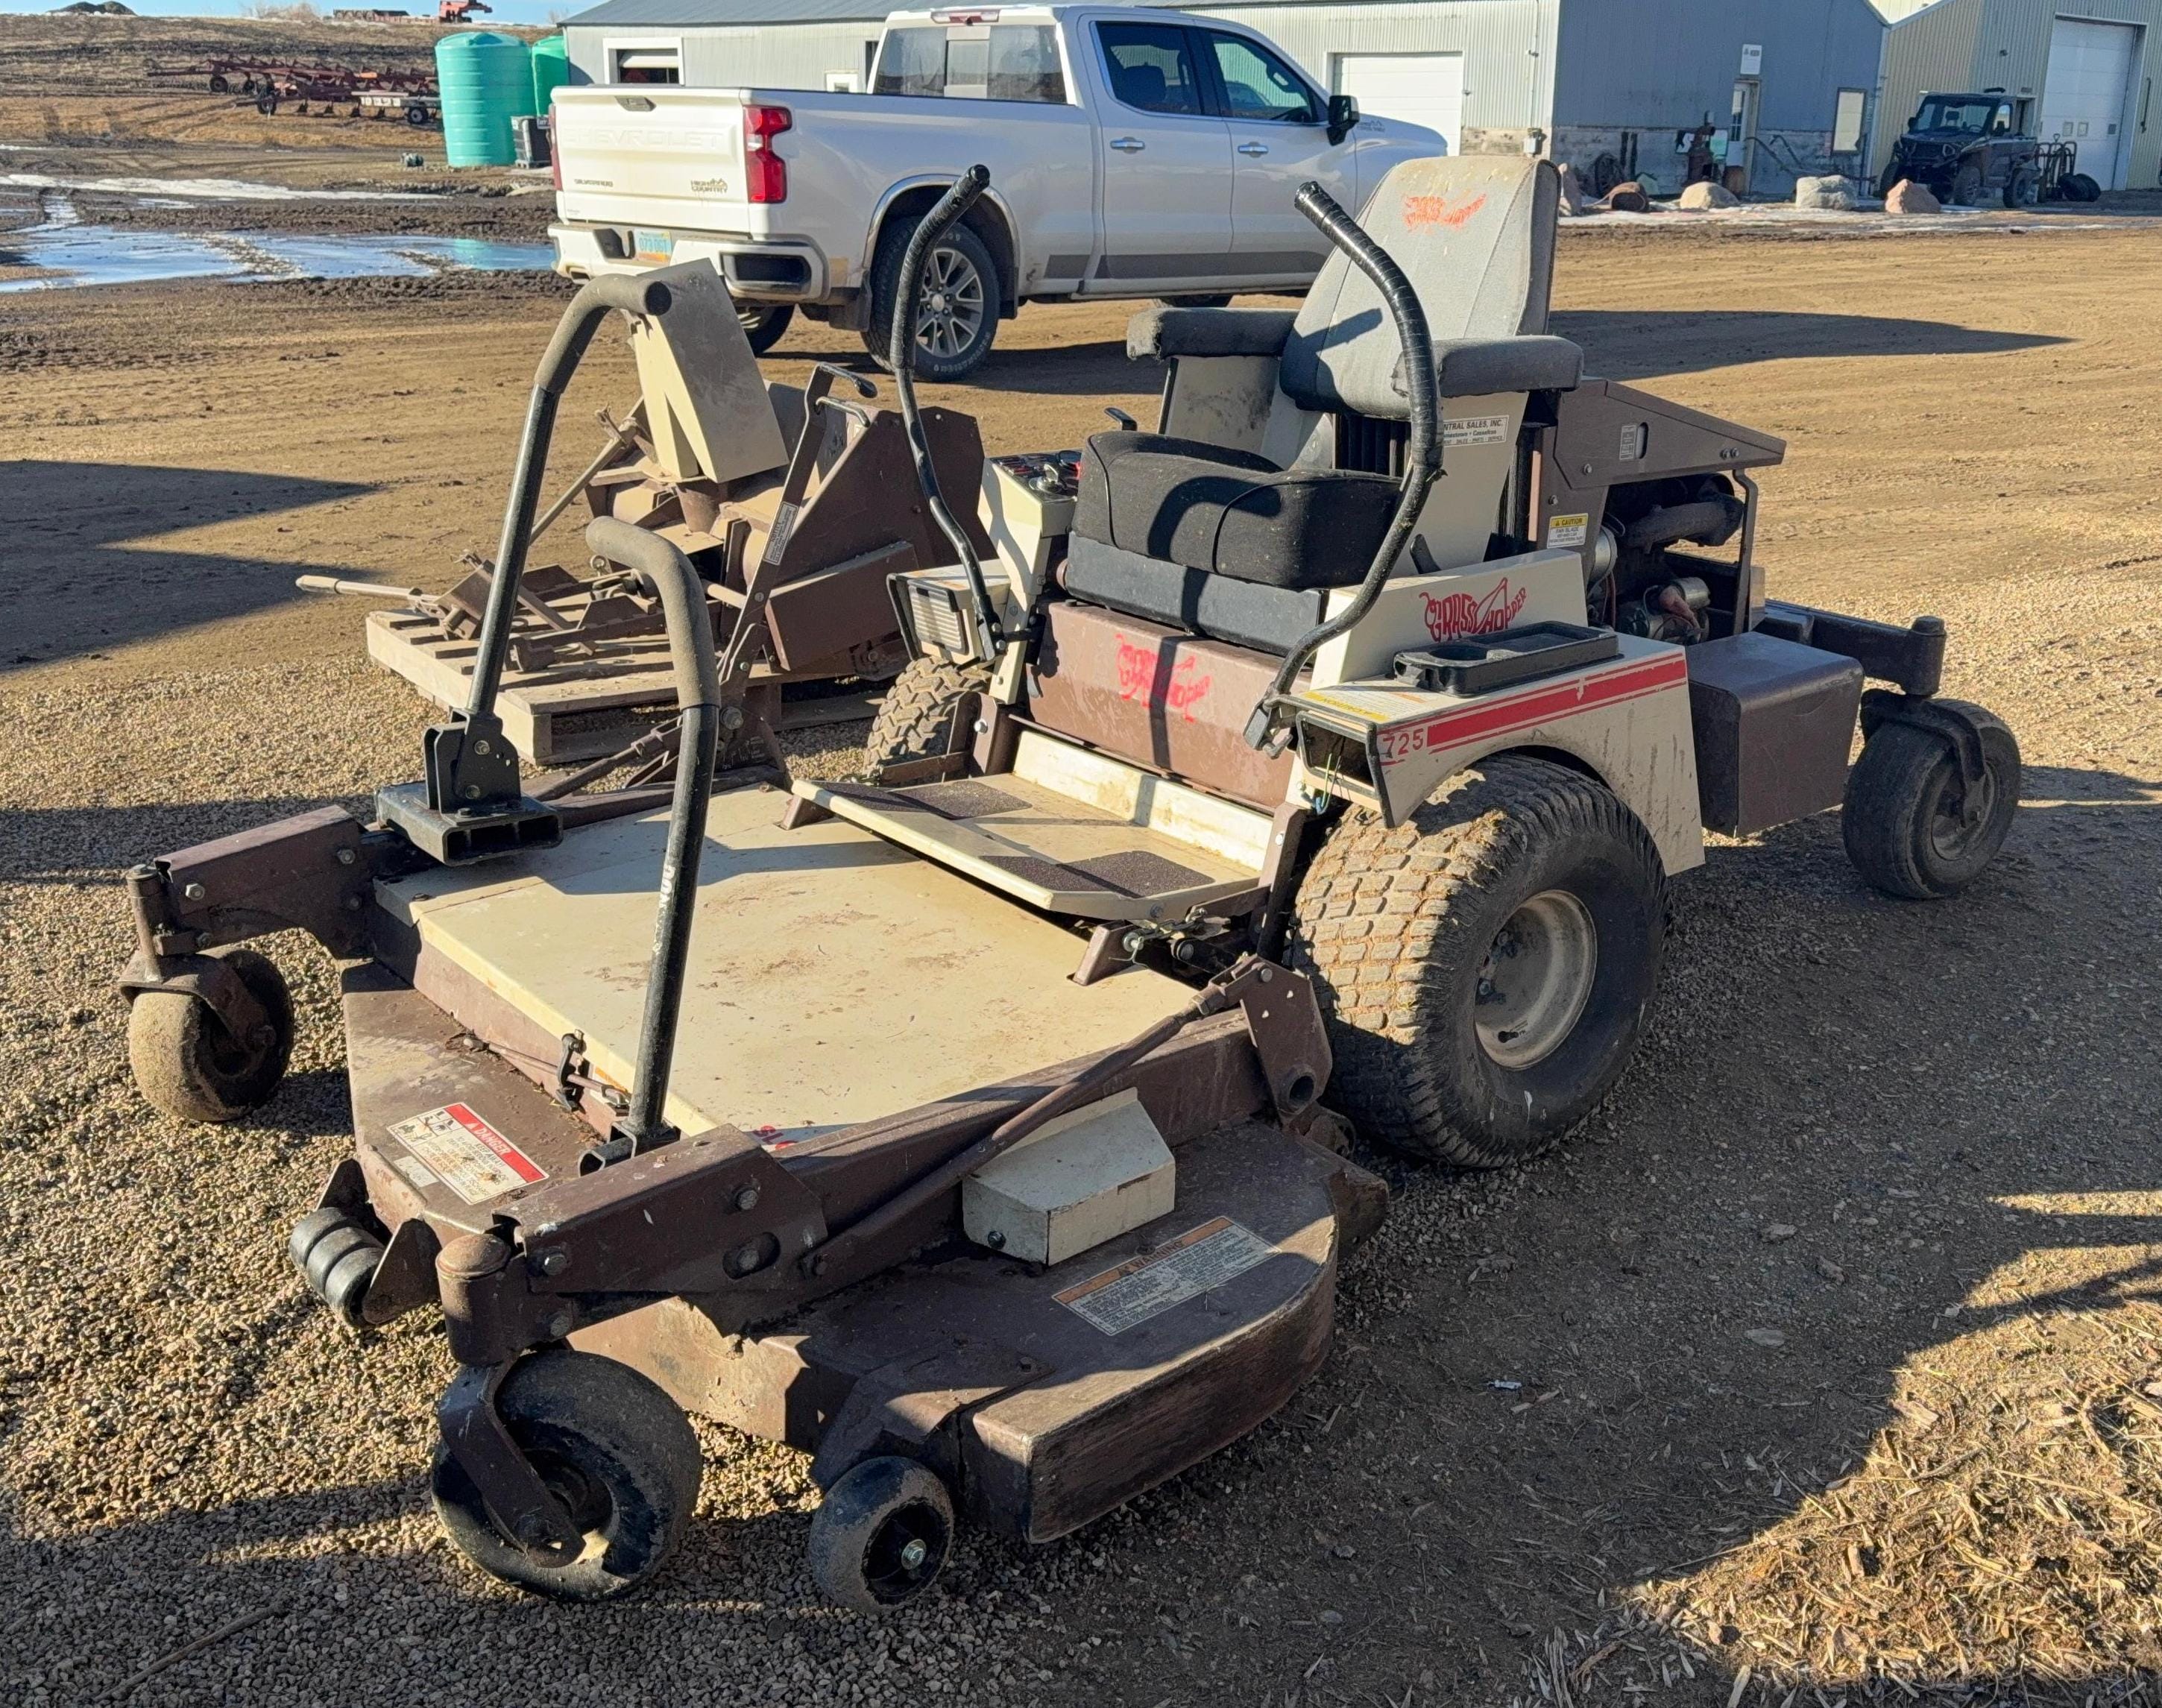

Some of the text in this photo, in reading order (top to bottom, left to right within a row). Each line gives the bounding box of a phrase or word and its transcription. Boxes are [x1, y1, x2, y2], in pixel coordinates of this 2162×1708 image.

[563, 127, 724, 148] CHEVROLET
[574, 178, 614, 187] SILVERADO
[1466, 420, 1489, 429] SALES,
[1420, 577, 1527, 642] GRASSHOPPER
[1383, 728, 1424, 759] 725
[473, 1128, 511, 1155] DANGER
[1130, 1240, 1184, 1267] WARNING
